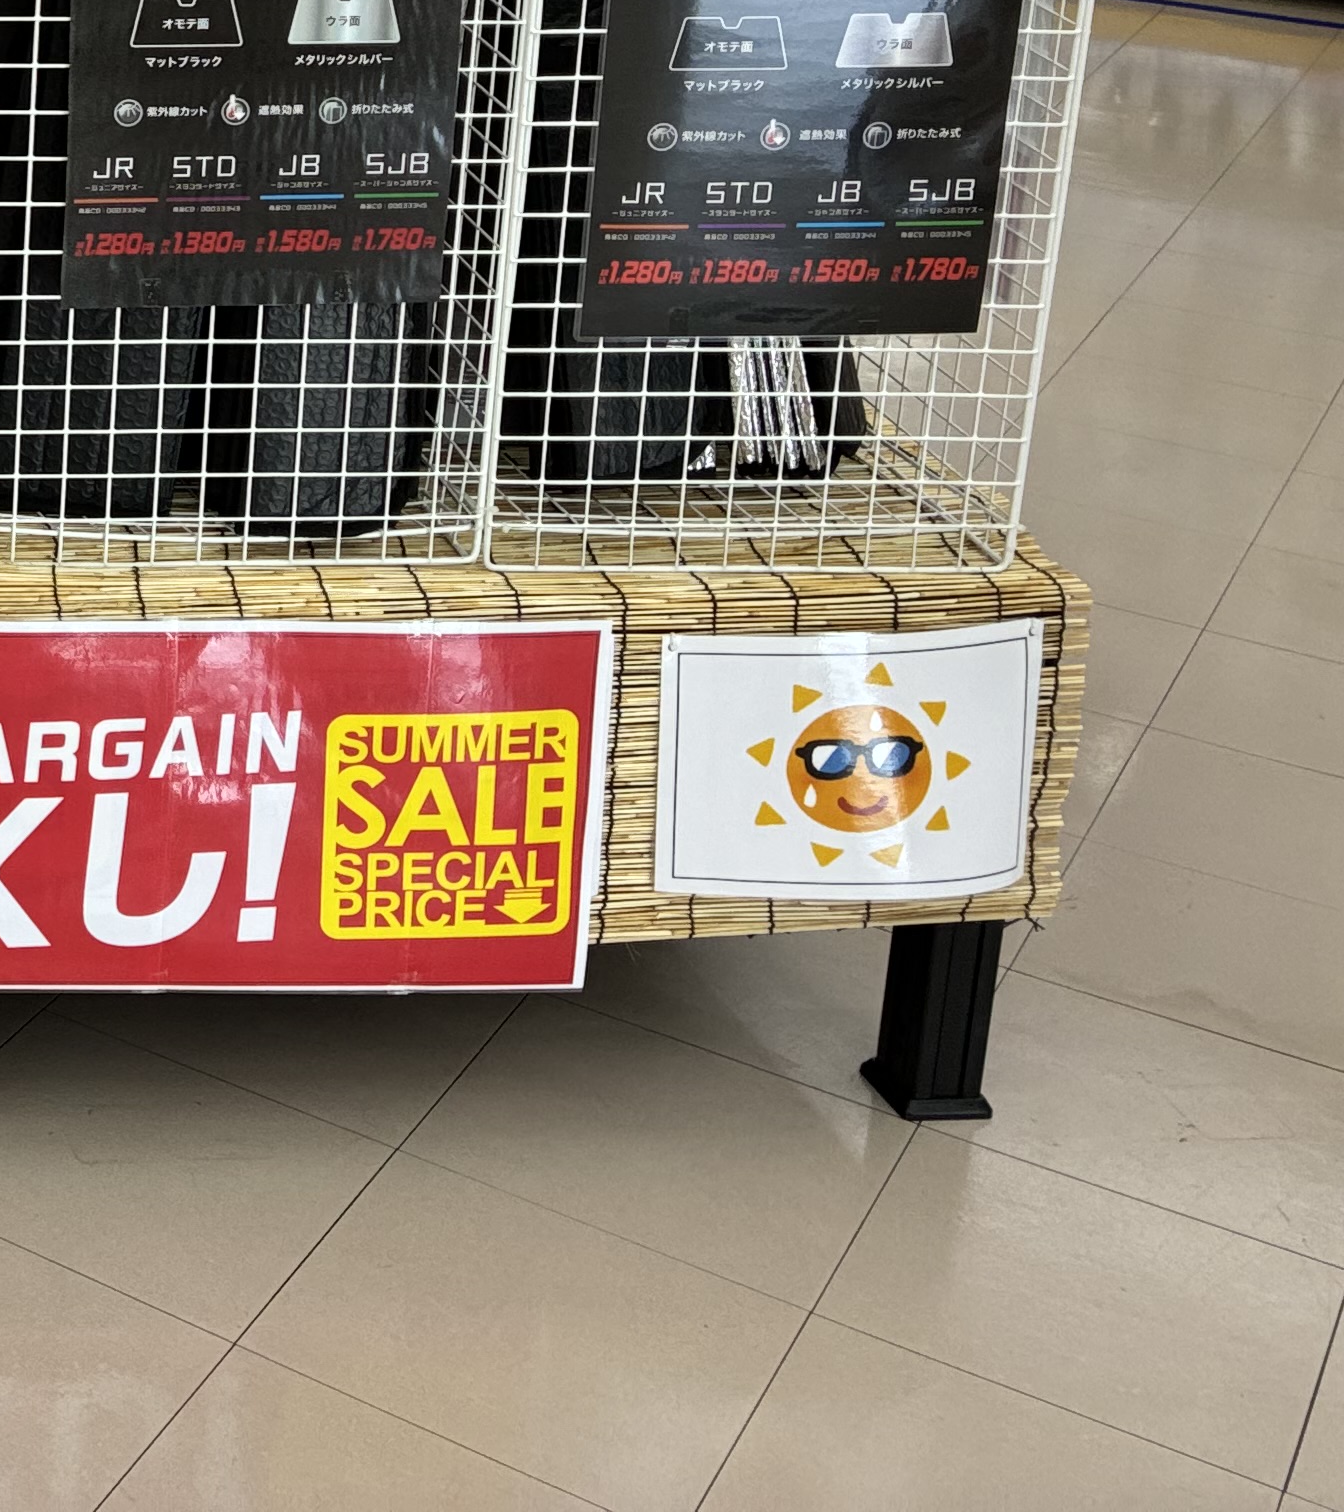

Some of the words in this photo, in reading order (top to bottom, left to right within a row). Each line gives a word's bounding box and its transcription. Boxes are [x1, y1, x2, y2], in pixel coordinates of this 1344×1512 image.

[162, 17, 210, 30] オモテ面
[145, 55, 222, 68] マットブラック
[841, 76, 944, 88] メタリックシルバー
[147, 105, 208, 117] 紫外線カット
[352, 104, 414, 116] 折りたたみ式
[92, 157, 135, 179] JR
[172, 156, 237, 178] STD
[279, 155, 320, 176] JB
[366, 153, 429, 175] SJB
[337, 722, 565, 769] SUMMER
[335, 763, 563, 848] SALE
